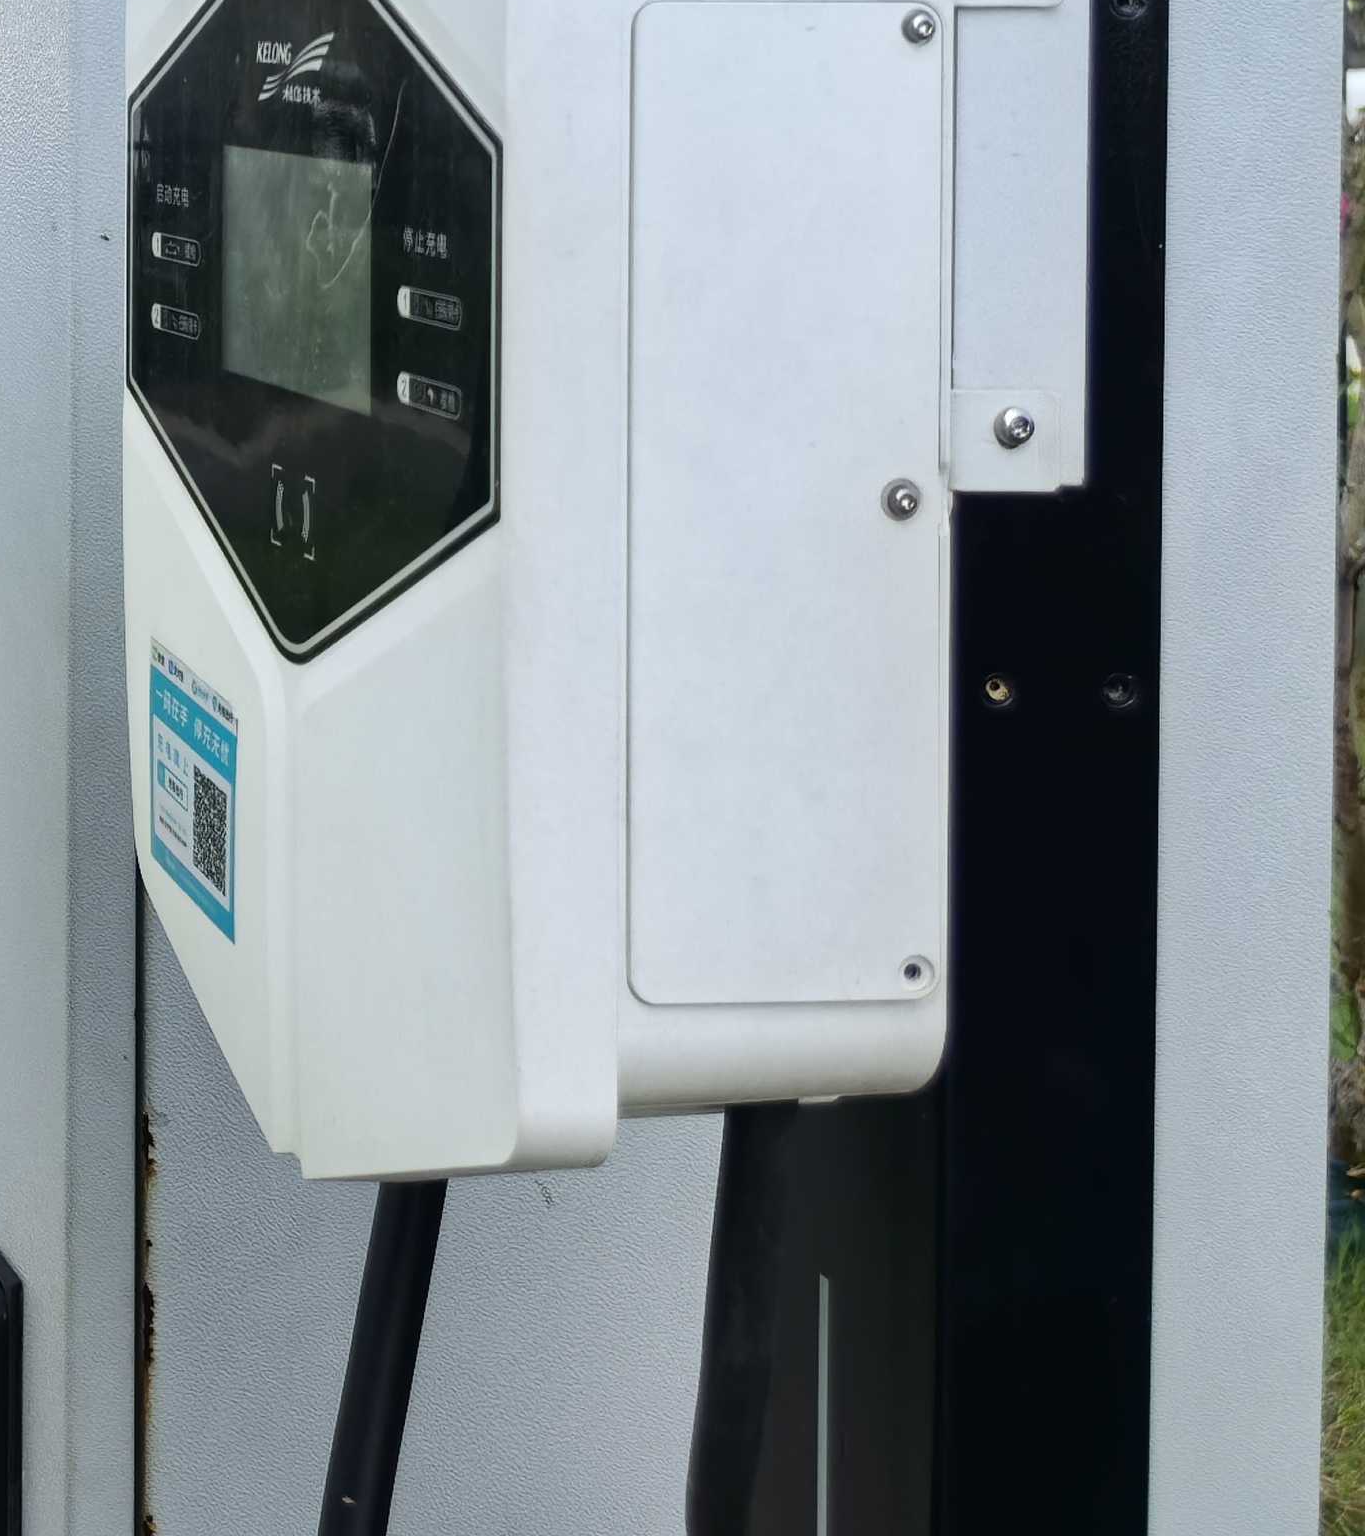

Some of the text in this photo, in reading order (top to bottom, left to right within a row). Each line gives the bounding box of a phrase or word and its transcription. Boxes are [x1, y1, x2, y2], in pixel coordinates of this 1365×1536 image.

[256, 40, 292, 66] KELONG
[403, 224, 448, 259] 停止充电
